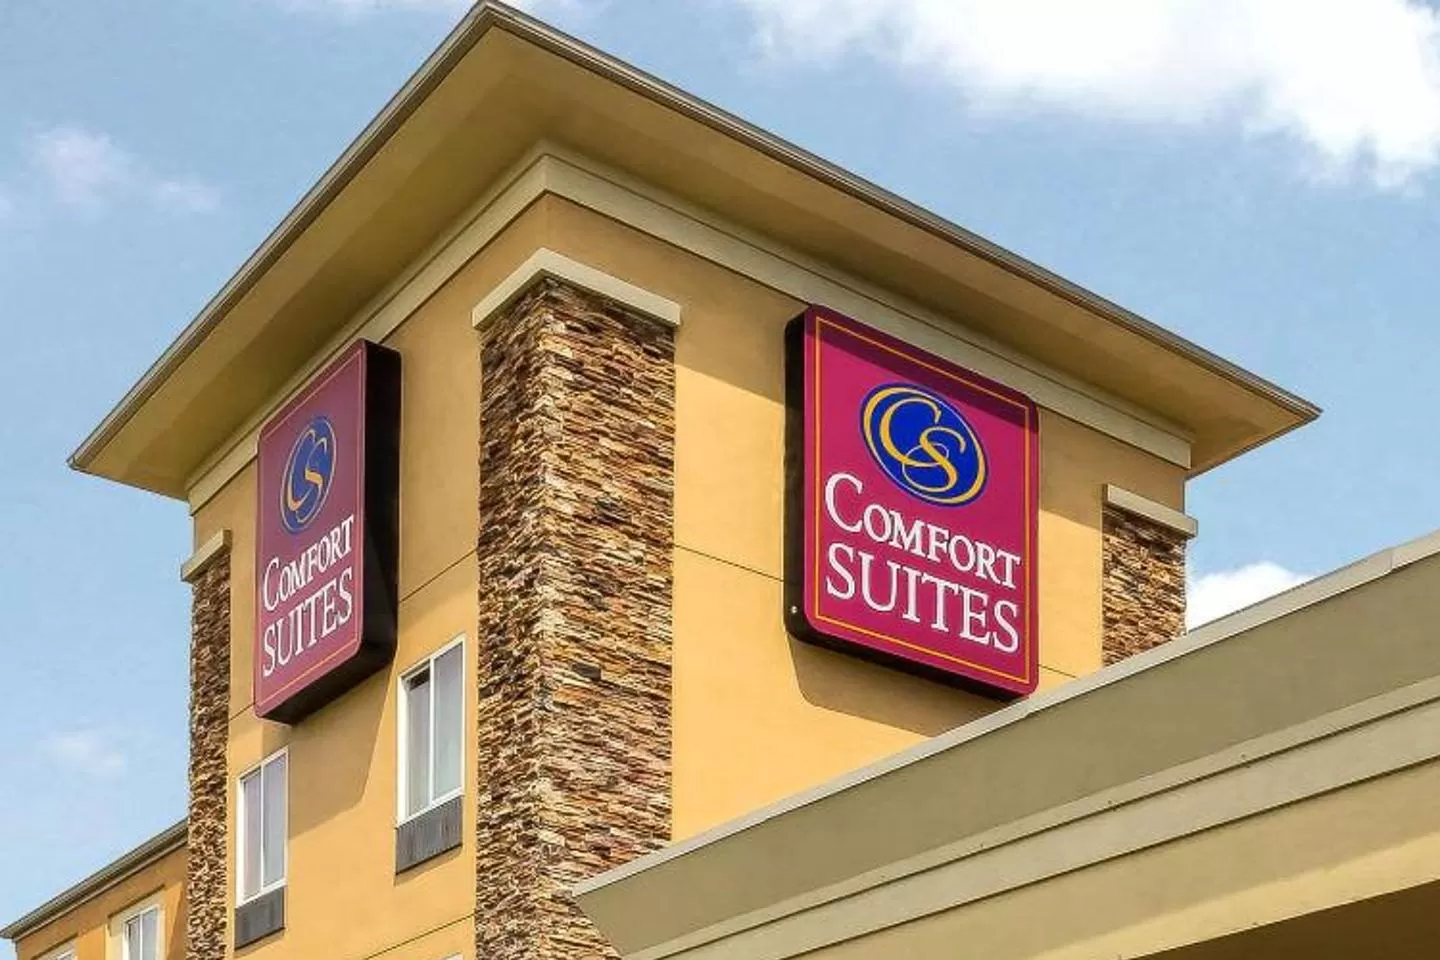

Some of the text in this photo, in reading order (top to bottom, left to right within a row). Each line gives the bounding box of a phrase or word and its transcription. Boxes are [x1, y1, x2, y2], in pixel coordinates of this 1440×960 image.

[263, 514, 354, 612] COMFORT
[824, 472, 1021, 589] COMFORT
[262, 566, 353, 677] SUITES
[825, 542, 1020, 653] SUITES
